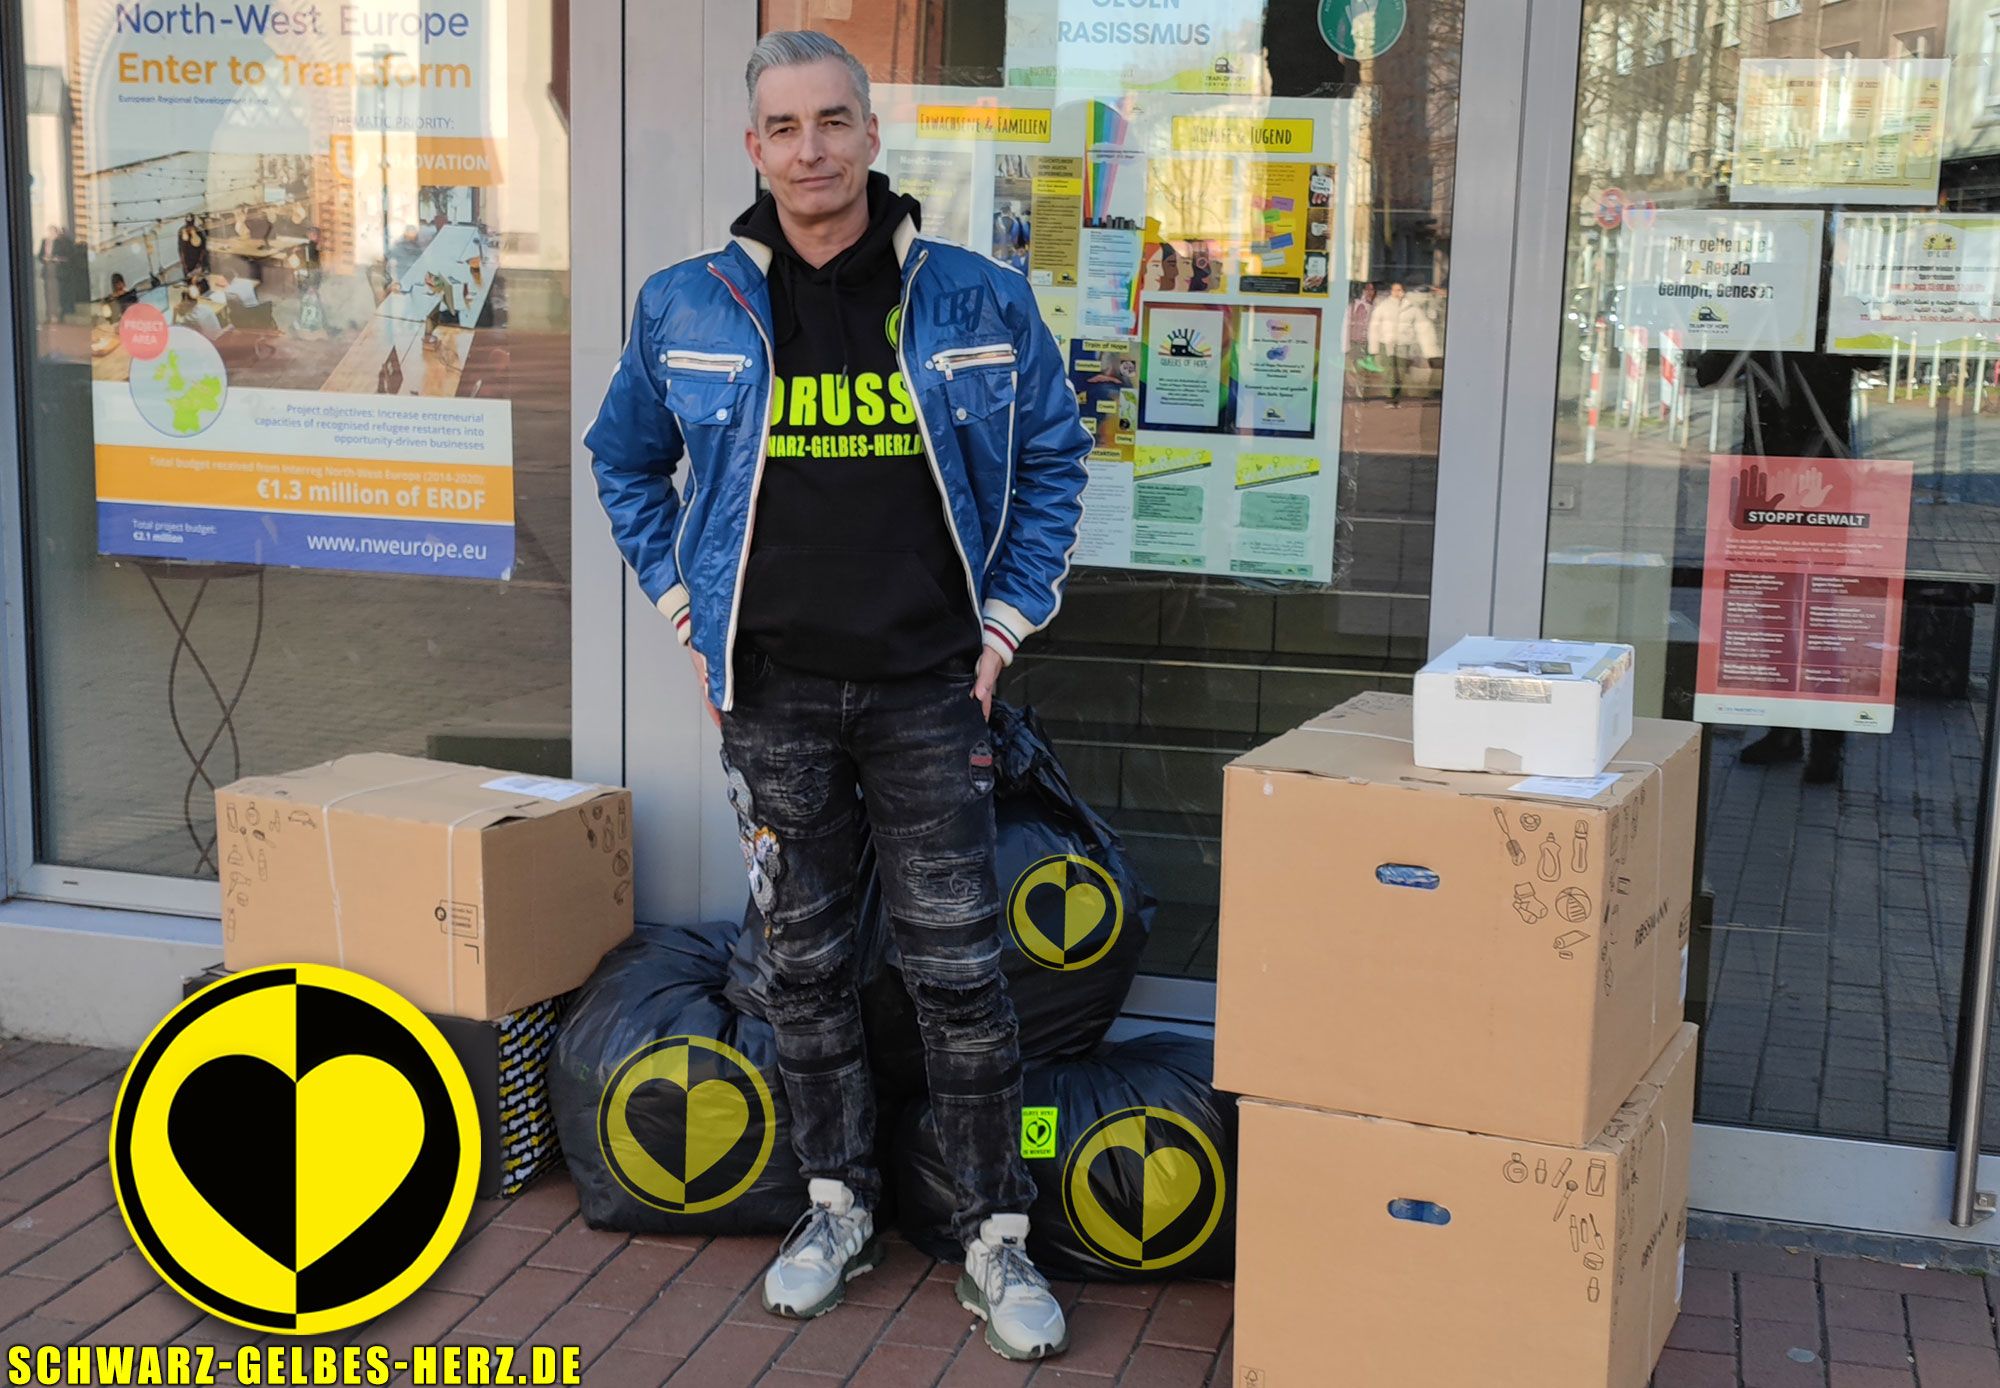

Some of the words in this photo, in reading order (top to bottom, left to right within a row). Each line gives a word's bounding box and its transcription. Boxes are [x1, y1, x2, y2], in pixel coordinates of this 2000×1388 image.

[116, 2, 321, 35] North-West
[340, 5, 469, 45] Europe
[1058, 20, 1211, 45] RASISSMUS
[118, 53, 218, 85] Enter
[228, 55, 266, 86] to
[275, 53, 471, 88] Transform
[329, 116, 392, 129] THEMATIC
[396, 117, 455, 129] PRIORITY:
[997, 116, 1048, 135] FAMILIEN
[1250, 126, 1292, 145] JUGEND
[286, 404, 320, 417] Project
[322, 405, 375, 419] objectives:
[378, 409, 419, 421] Increase
[421, 411, 484, 423] entreneurial
[254, 417, 302, 429] capacities
[304, 417, 314, 428] of
[316, 419, 370, 433] recognised
[372, 422, 410, 435] refugee
[412, 425, 461, 436] restarters
[464, 426, 485, 437] into
[334, 434, 427, 448] opportunity-driven
[429, 439, 485, 450] businesses
[149, 456, 174, 467] Total
[176, 458, 210, 471] budget
[256, 478, 302, 500] €1.3
[309, 481, 389, 506] million
[396, 486, 421, 507] of
[426, 487, 486, 510] ERDF
[132, 518, 153, 530] Total
[154, 520, 184, 533] project
[1748, 511, 1804, 524] STOPPT
[1806, 513, 1866, 526] GEWALT
[152, 532, 184, 544] million
[307, 534, 487, 562] www.nweurope.eu
